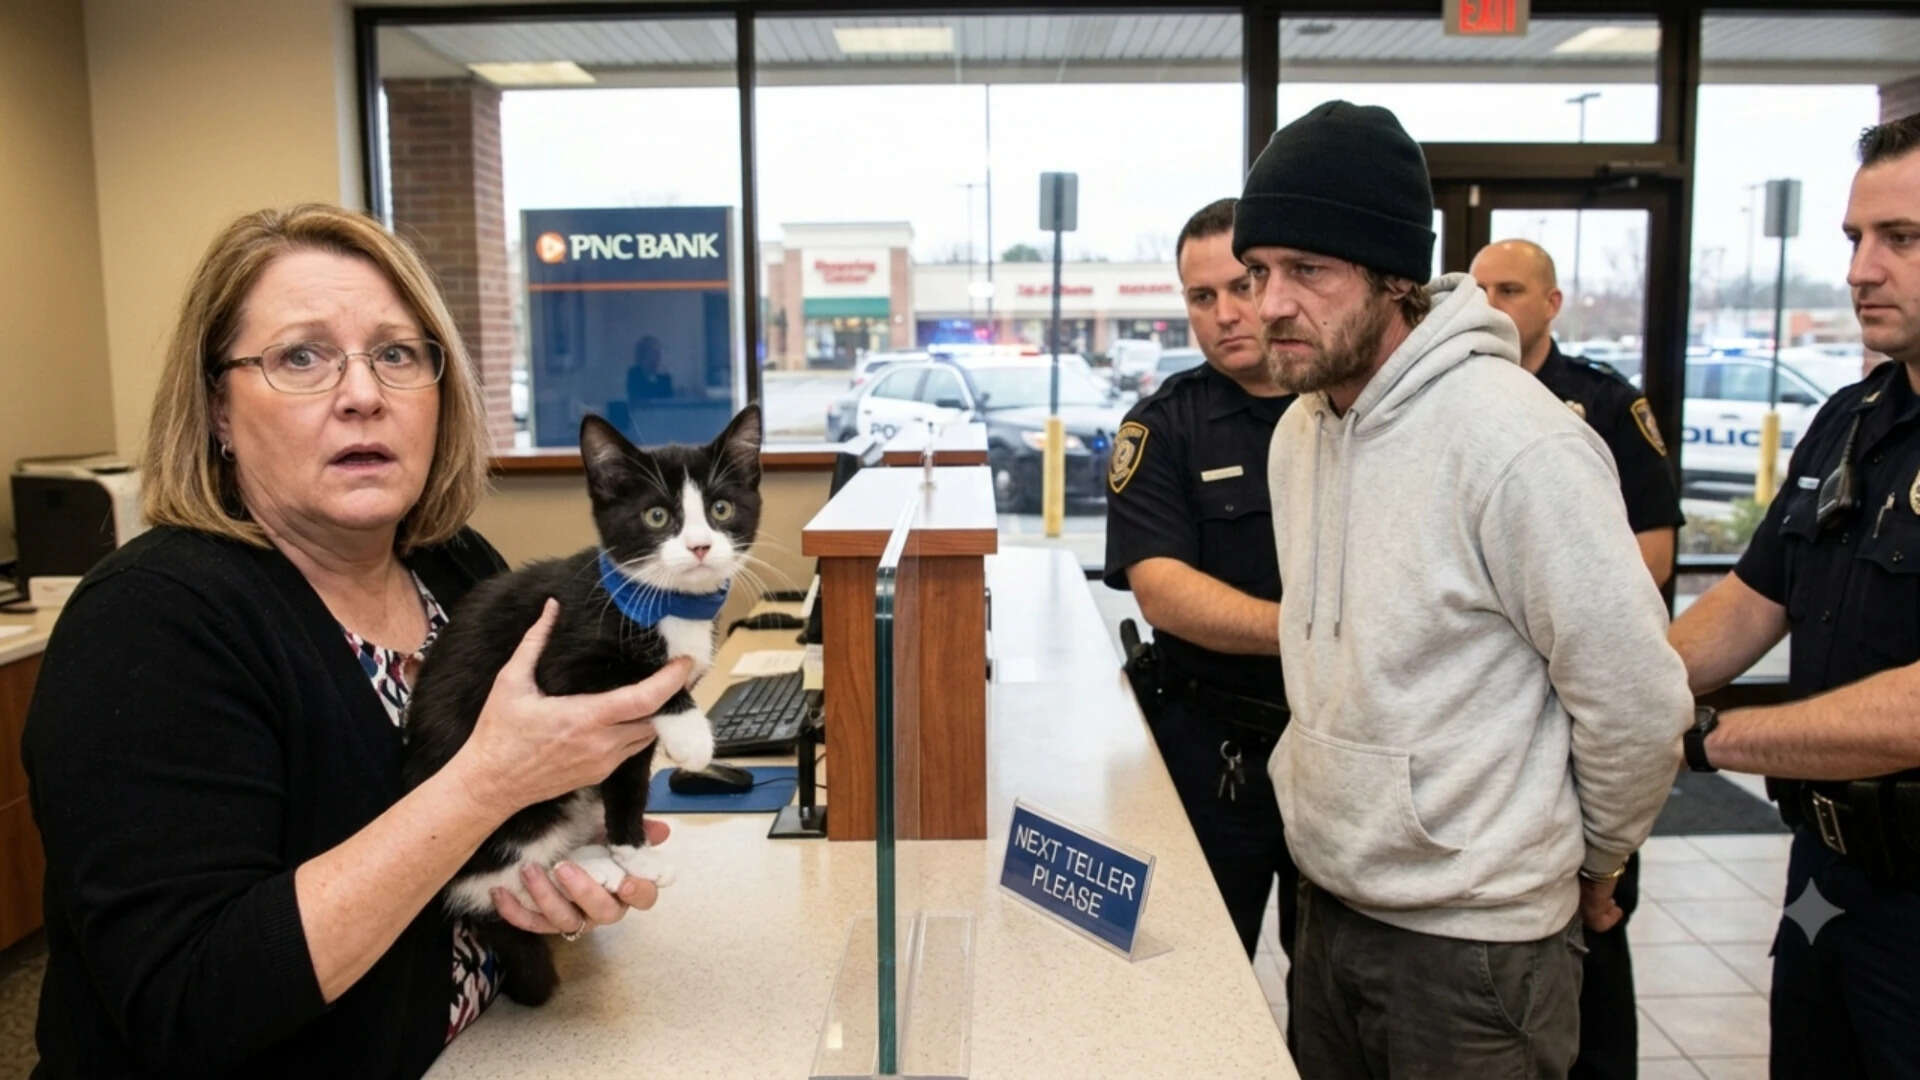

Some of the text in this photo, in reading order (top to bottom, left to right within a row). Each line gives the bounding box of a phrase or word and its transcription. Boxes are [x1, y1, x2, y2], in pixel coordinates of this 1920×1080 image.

[569, 232, 720, 260] PNC BANK
[1682, 427, 1796, 449] OLICE
[1014, 823, 1136, 901] NEXT TELLER
[1031, 863, 1104, 919] PLEASE
